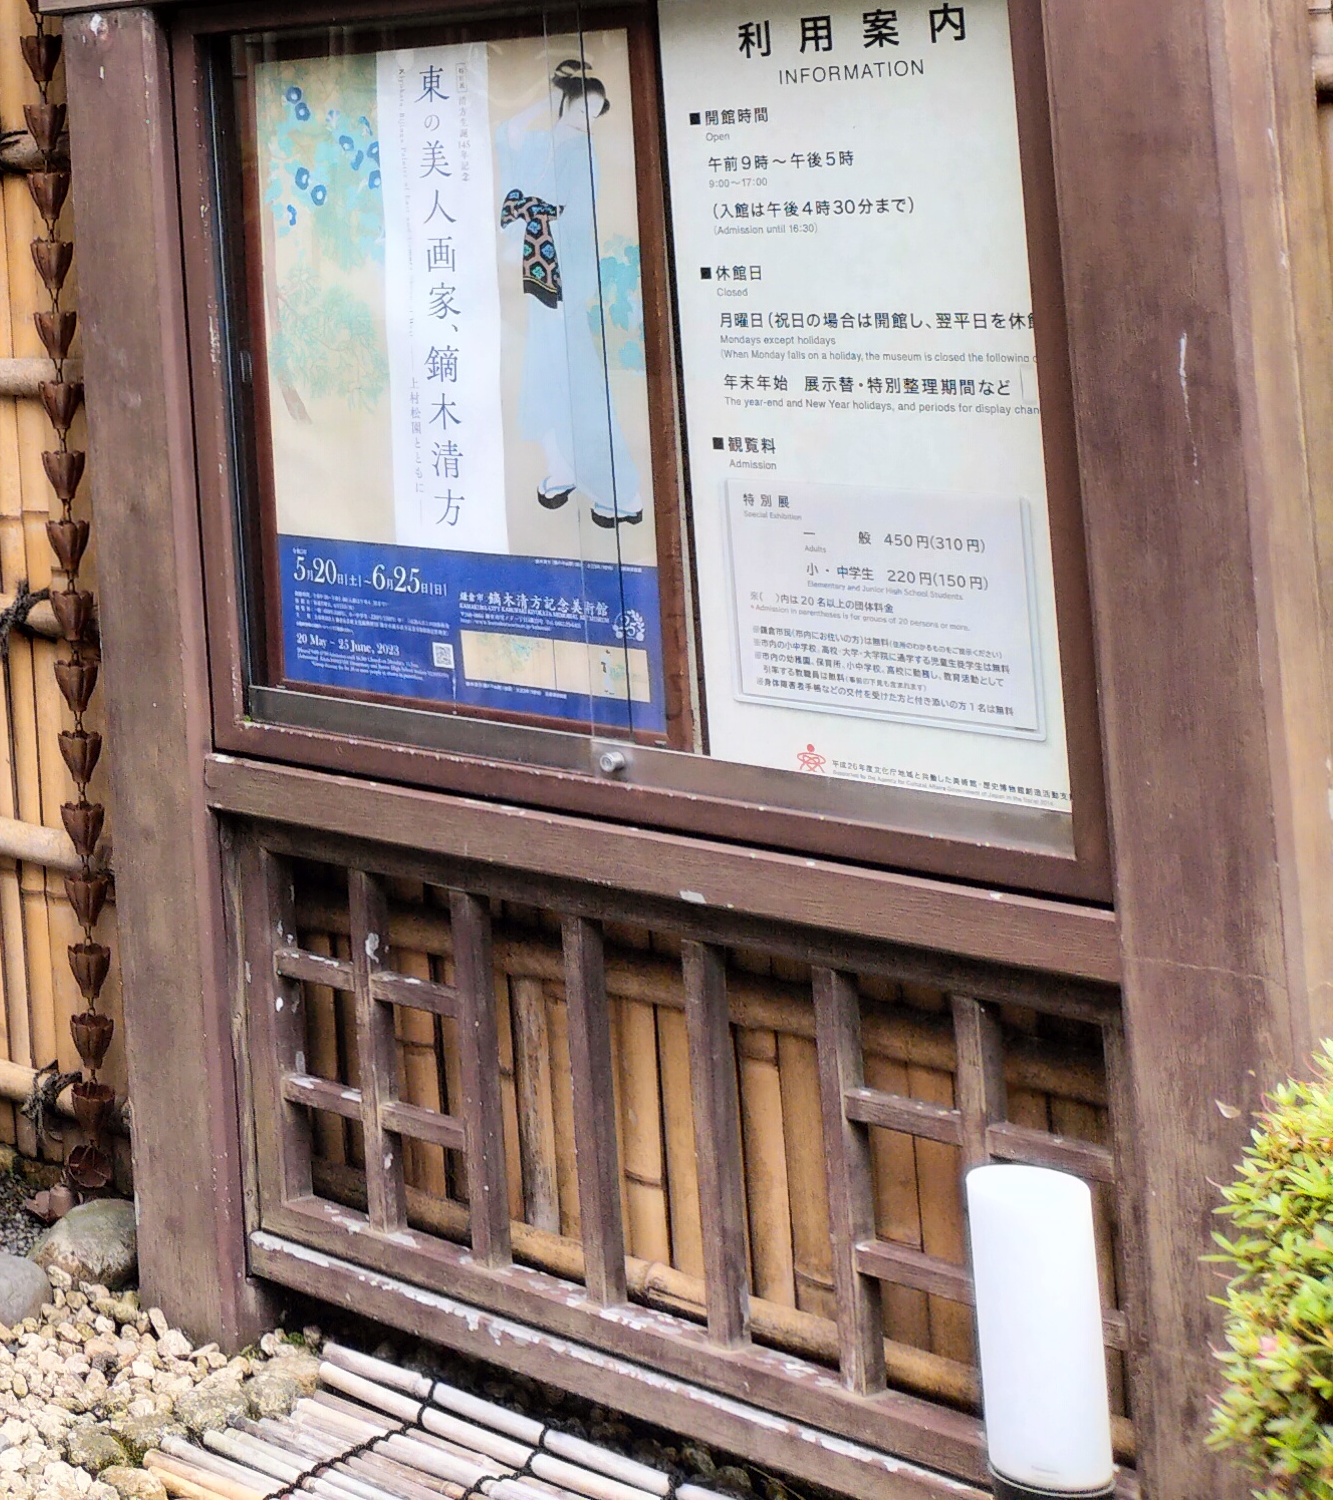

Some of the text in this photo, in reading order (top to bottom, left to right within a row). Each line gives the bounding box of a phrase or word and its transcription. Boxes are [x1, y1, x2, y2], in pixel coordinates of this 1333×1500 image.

[738, 3, 966, 59] 利用案内
[779, 59, 925, 85] INFORMATION
[704, 107, 769, 126] 開館時間
[706, 131, 730, 142] Open
[714, 222, 818, 236] (Admission until 16:30)
[716, 265, 762, 283] 休館日
[414, 64, 465, 527] 東の美人画家、鏑木清方
[717, 287, 748, 298] Closed
[720, 334, 836, 347] Mondays except holidays
[752, 349, 786, 362] Monday
[809, 353, 820, 361] on
[866, 351, 880, 361] the
[883, 354, 922, 362] museum
[925, 352, 933, 362] is
[935, 352, 965, 362] closed
[968, 352, 984, 362] the
[724, 374, 1011, 397] 年末年始 展示替・特別整理期間など
[725, 396, 742, 407] The
[744, 398, 784, 409] year-end
[786, 398, 803, 408] and
[805, 399, 825, 409] New
[828, 399, 850, 409] Year
[853, 400, 895, 412] holidays,
[898, 401, 915, 412] and
[919, 402, 956, 414] periods
[958, 402, 972, 413] for
[975, 403, 1011, 416] display
[728, 436, 776, 455] 観覧料
[729, 459, 777, 470] Admission
[743, 493, 790, 509] 特別展
[806, 562, 874, 582] 小・中学生
[487, 591, 609, 617] 鏑木清方記念美術館
[309, 633, 328, 647] May
